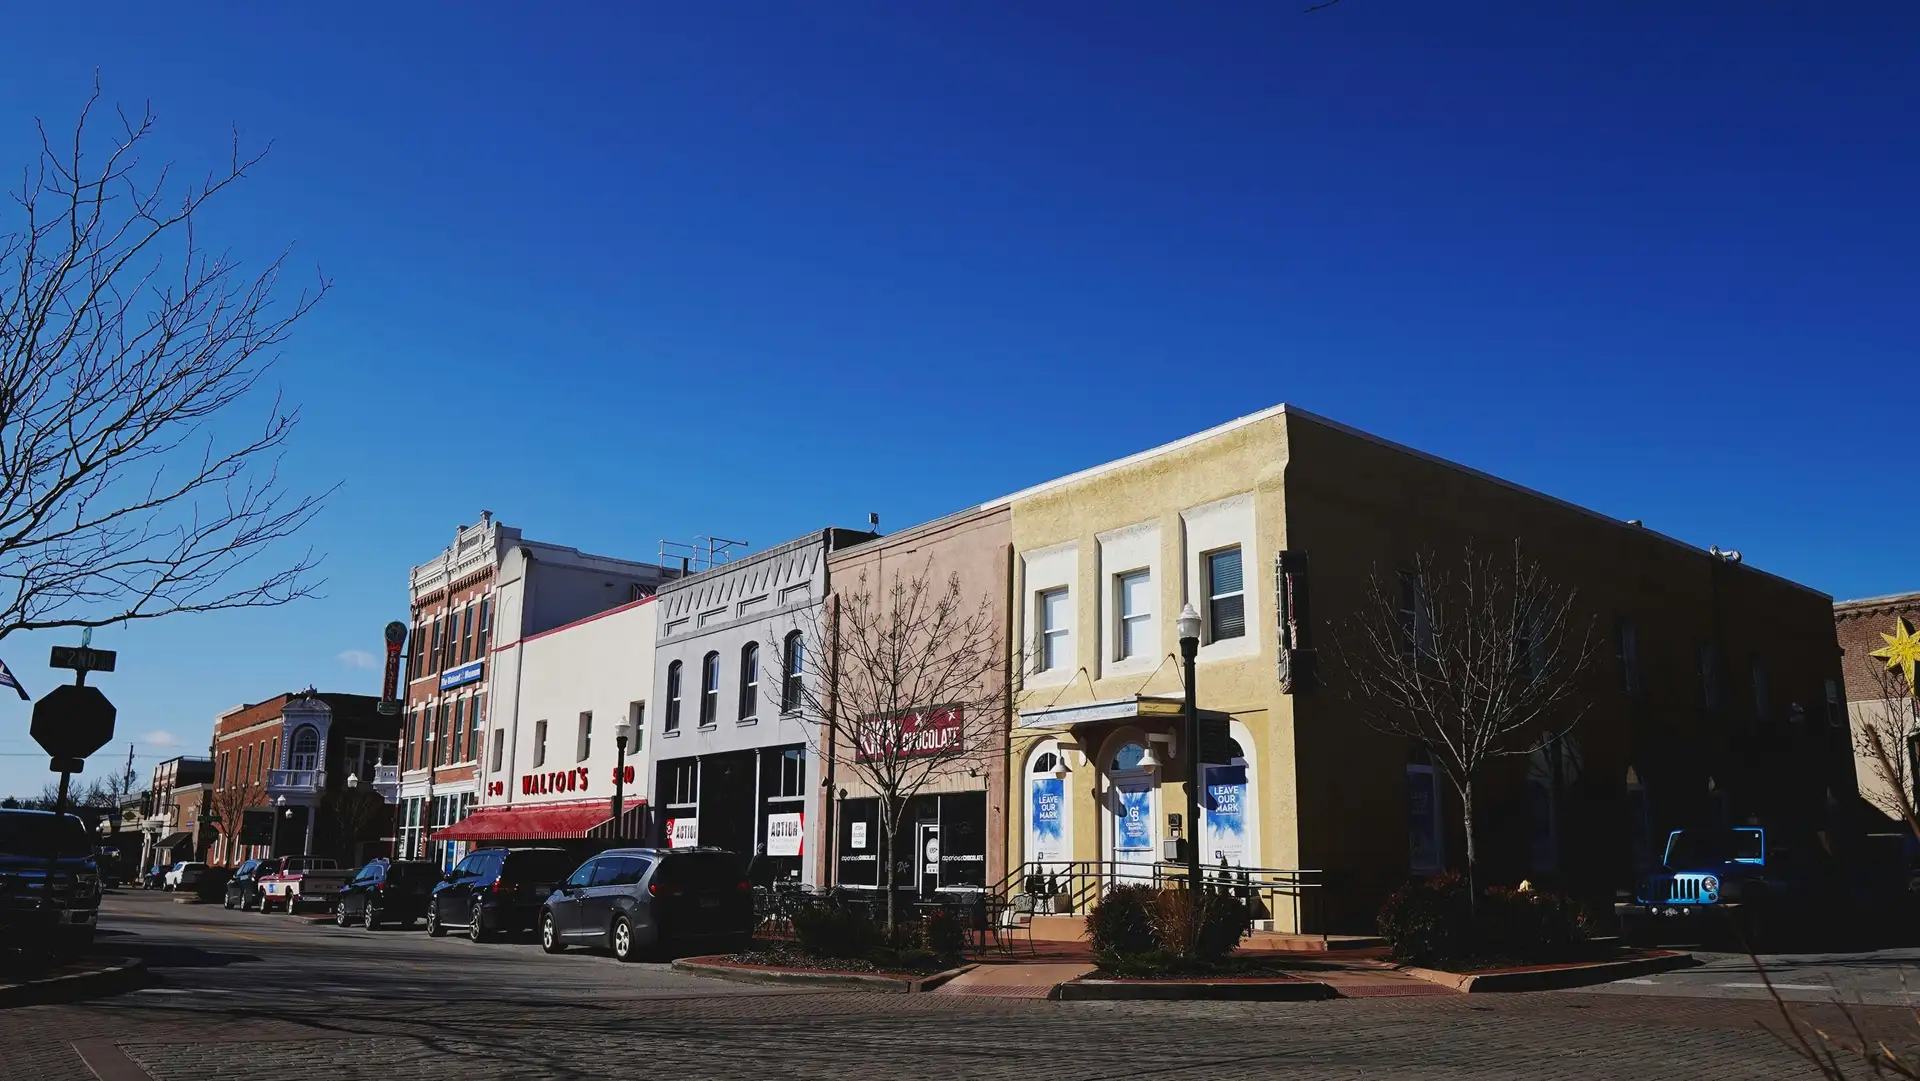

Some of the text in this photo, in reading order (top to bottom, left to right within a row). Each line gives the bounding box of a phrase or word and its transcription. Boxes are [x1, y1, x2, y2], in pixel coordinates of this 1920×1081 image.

[67, 650, 97, 669] 2ND
[902, 726, 960, 752] CHOCOLATE
[612, 765, 635, 785] 510
[522, 767, 589, 796] WALTON'S
[1215, 786, 1240, 796] LEAVE
[1039, 795, 1058, 804] LEAVE
[1217, 795, 1236, 804] OUR
[1041, 803, 1056, 811] OUR
[1215, 804, 1239, 813] MARK
[1039, 811, 1058, 819] MARK
[675, 824, 697, 839] ACTIO
[770, 821, 798, 837] ACTION
